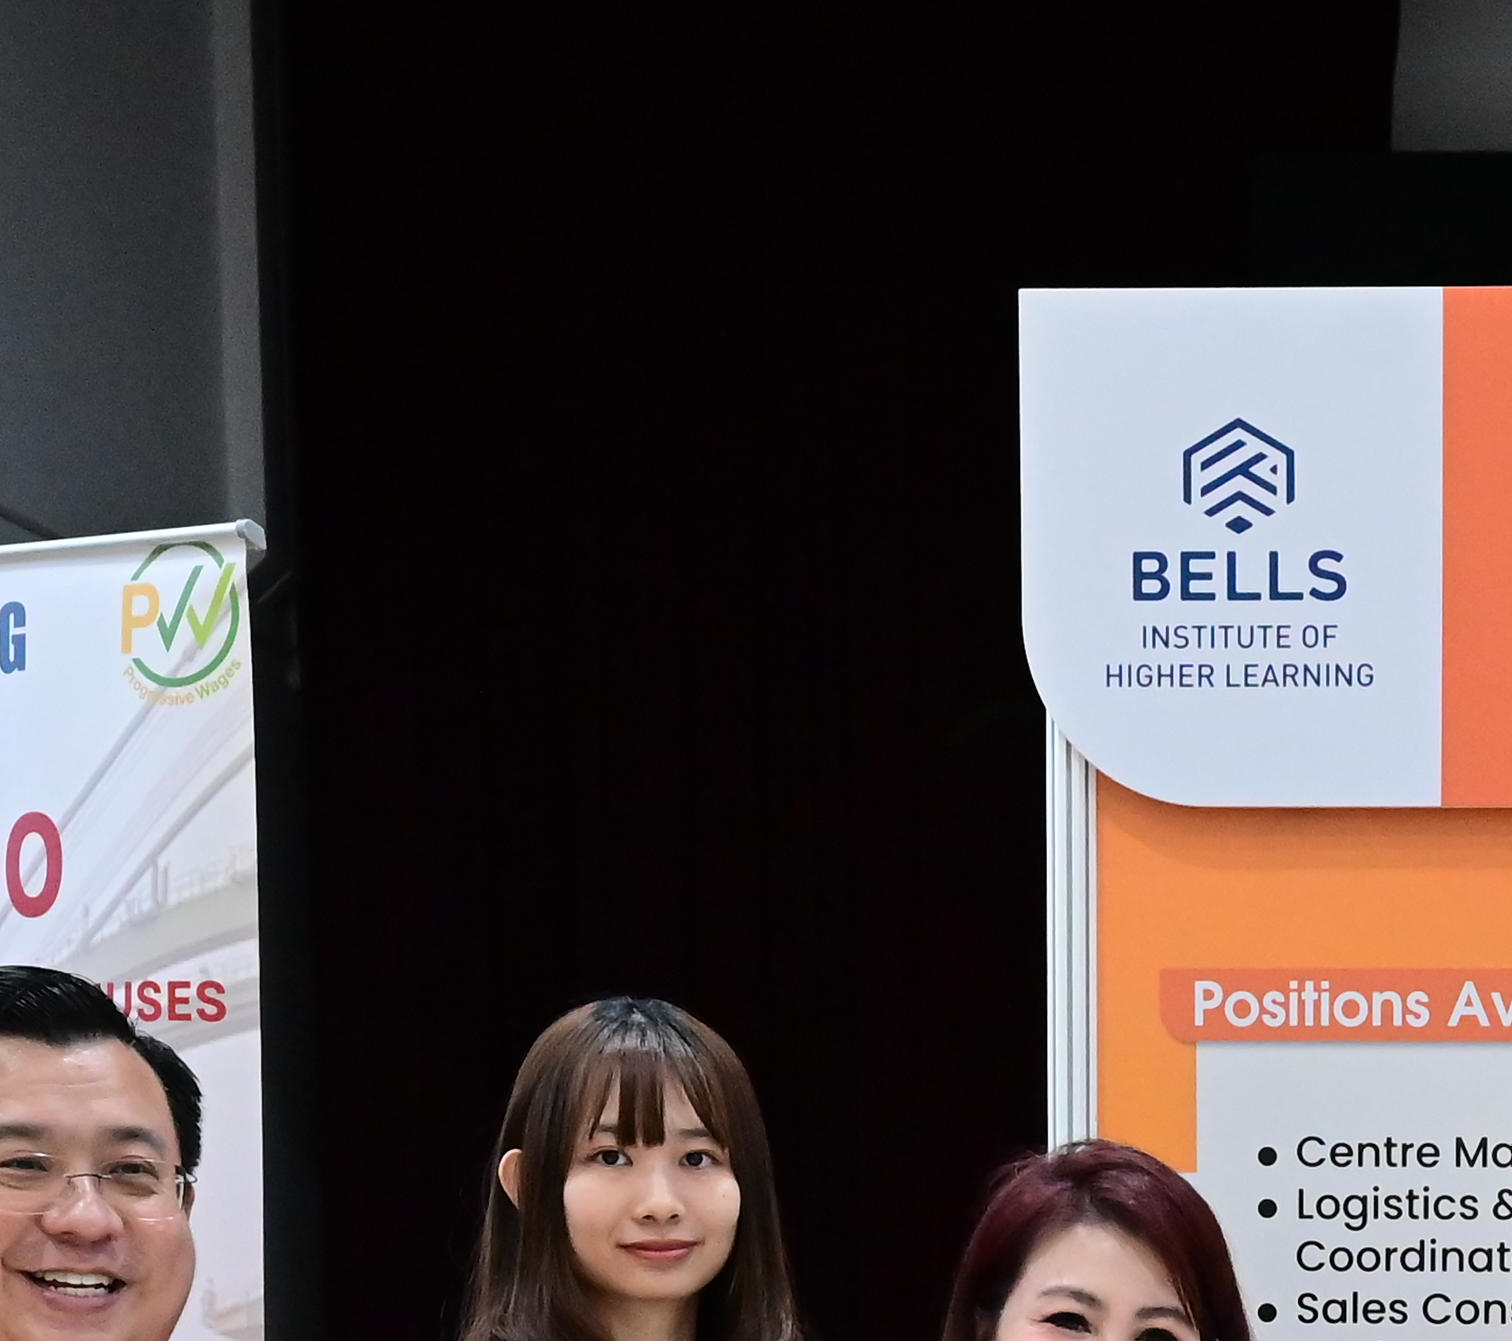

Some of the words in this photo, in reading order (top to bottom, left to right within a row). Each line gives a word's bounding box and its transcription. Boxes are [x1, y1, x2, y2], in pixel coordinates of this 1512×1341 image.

[1133, 549, 1347, 602] BELLS
[1140, 623, 1293, 651] INSTITUTE
[1303, 623, 1339, 651] OF
[194, 658, 242, 700] Wages
[1106, 663, 1215, 691] HIGHER
[1224, 663, 1376, 690] LEARNING
[1192, 979, 1431, 1028] Positions
[1296, 1136, 1440, 1168] Centre
[1298, 1186, 1479, 1232] Logistics
[1297, 1291, 1408, 1324] Sales
